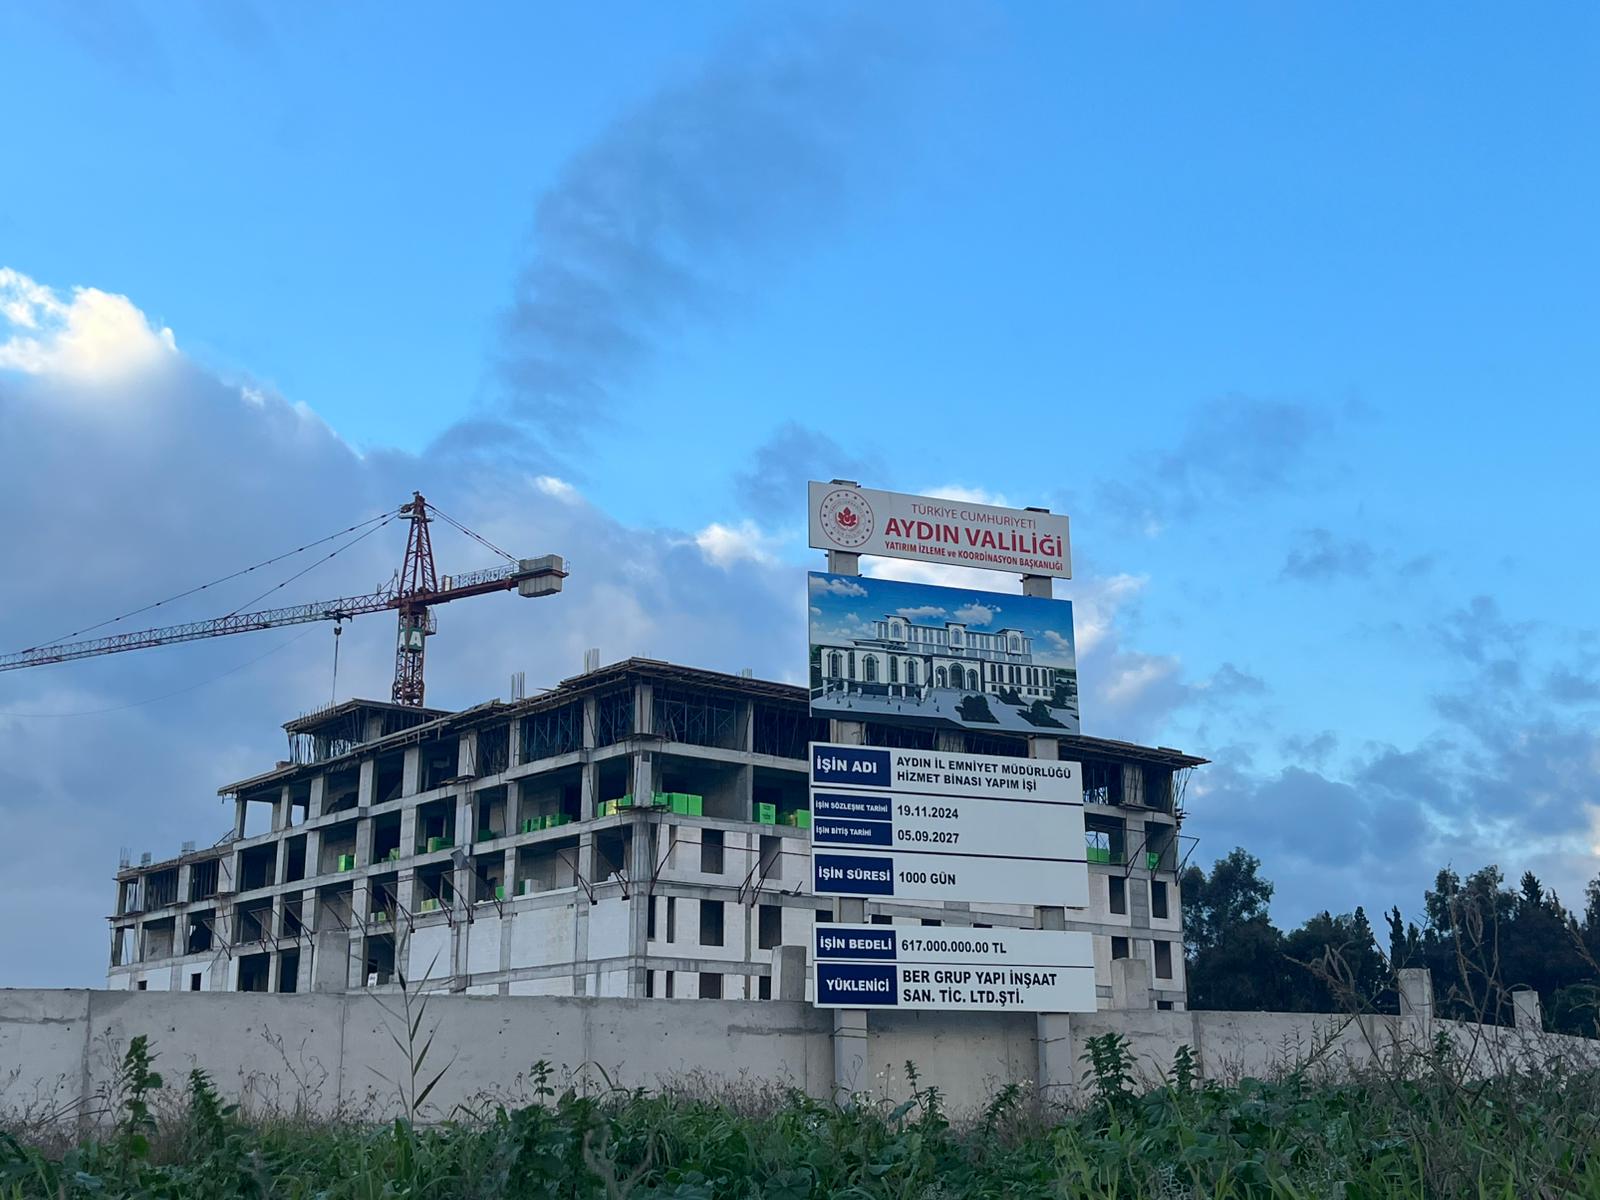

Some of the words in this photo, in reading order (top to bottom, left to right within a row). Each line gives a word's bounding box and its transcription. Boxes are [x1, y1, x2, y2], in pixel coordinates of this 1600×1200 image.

[911, 503, 957, 519] TÜRKİYE
[960, 510, 1036, 529] CUMHURİYETİ
[885, 518, 959, 544] AYDIN
[965, 527, 1063, 557] VALİLİĞİ
[885, 540, 917, 553] YATIRIM
[918, 543, 946, 557] İZLEME
[947, 550, 957, 558] ve
[958, 550, 1019, 565] KOORDİNASYON
[1019, 558, 1063, 571] BAŞKANLIĞI
[816, 755, 848, 774] İŞİN
[852, 759, 877, 774] ADI
[897, 756, 931, 769] AYDIN
[934, 756, 946, 770] İL
[949, 757, 998, 774] EMNİYET
[1001, 762, 1071, 779] MÜDÜRLÜĞÜ
[897, 769, 939, 784] HİZMET
[943, 772, 982, 787] BİNASI
[985, 777, 1019, 789] YAPIM
[1022, 777, 1037, 792] İŞİ
[815, 800, 830, 810] İŞİN
[830, 801, 865, 812] SÖZLEŞME
[865, 804, 888, 813] TARİHİ
[897, 805, 959, 819] 19.11.2024
[815, 825, 830, 835] İŞİN
[831, 826, 849, 837] BİTİŞ
[849, 827, 872, 837] TARİHİ
[897, 829, 960, 844] 05.09.2027
[818, 866, 844, 880] İŞİN
[846, 868, 891, 882] SÜRESİ
[899, 872, 927, 884] 1000
[930, 872, 956, 886] GÜN
[820, 935, 846, 951] İŞİN
[848, 938, 892, 951] BEDELİ
[901, 940, 989, 954] 617.000.000.00
[992, 943, 1007, 954] TL
[826, 977, 890, 992] YÜKLENİCİ
[903, 970, 930, 983] BER
[934, 970, 971, 985] GRUP
[975, 972, 1005, 985] YAPI
[1009, 970, 1057, 988] İNŞAAT
[903, 989, 935, 1003] SAN.
[938, 987, 966, 1003] TİC.
[970, 989, 1024, 1007] LTD.ŞTİ.
